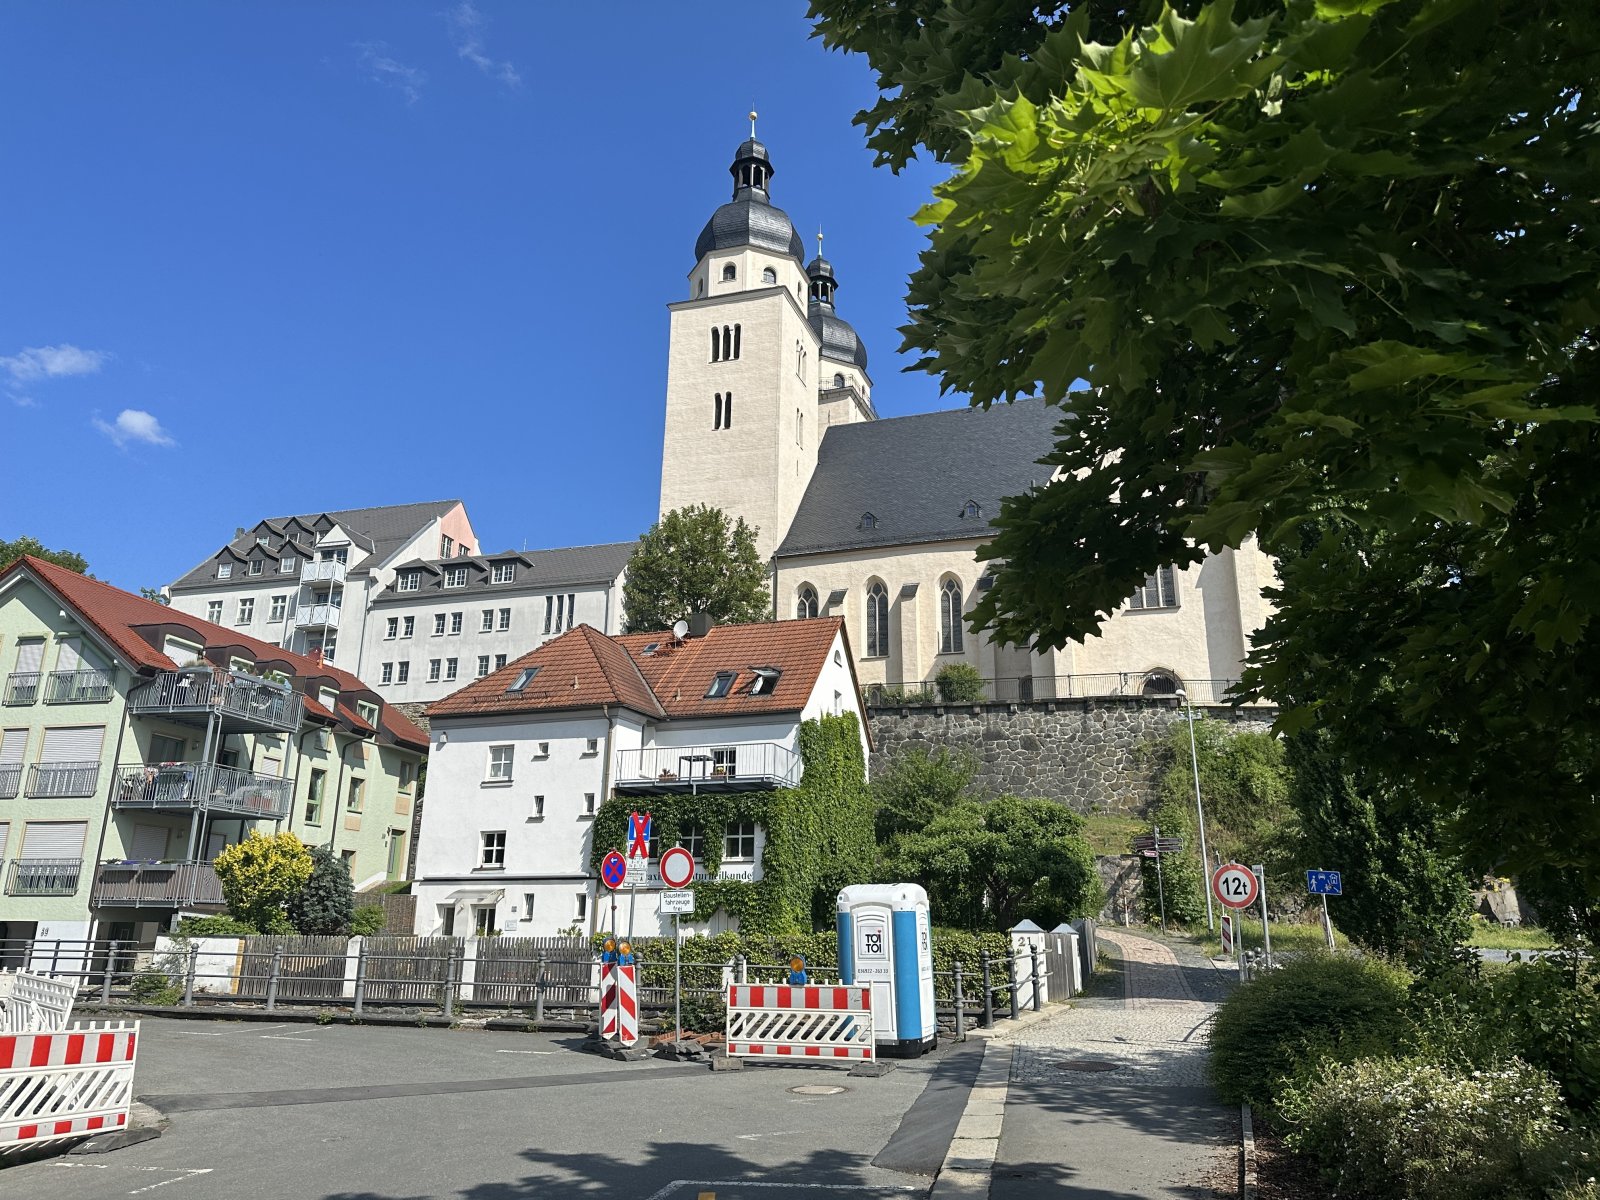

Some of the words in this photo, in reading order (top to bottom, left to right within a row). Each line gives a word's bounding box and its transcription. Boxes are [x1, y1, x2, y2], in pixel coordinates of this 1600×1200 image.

[1222, 876, 1248, 895] 12t
[1018, 936, 1031, 947] 21
[866, 944, 882, 953] TOI
